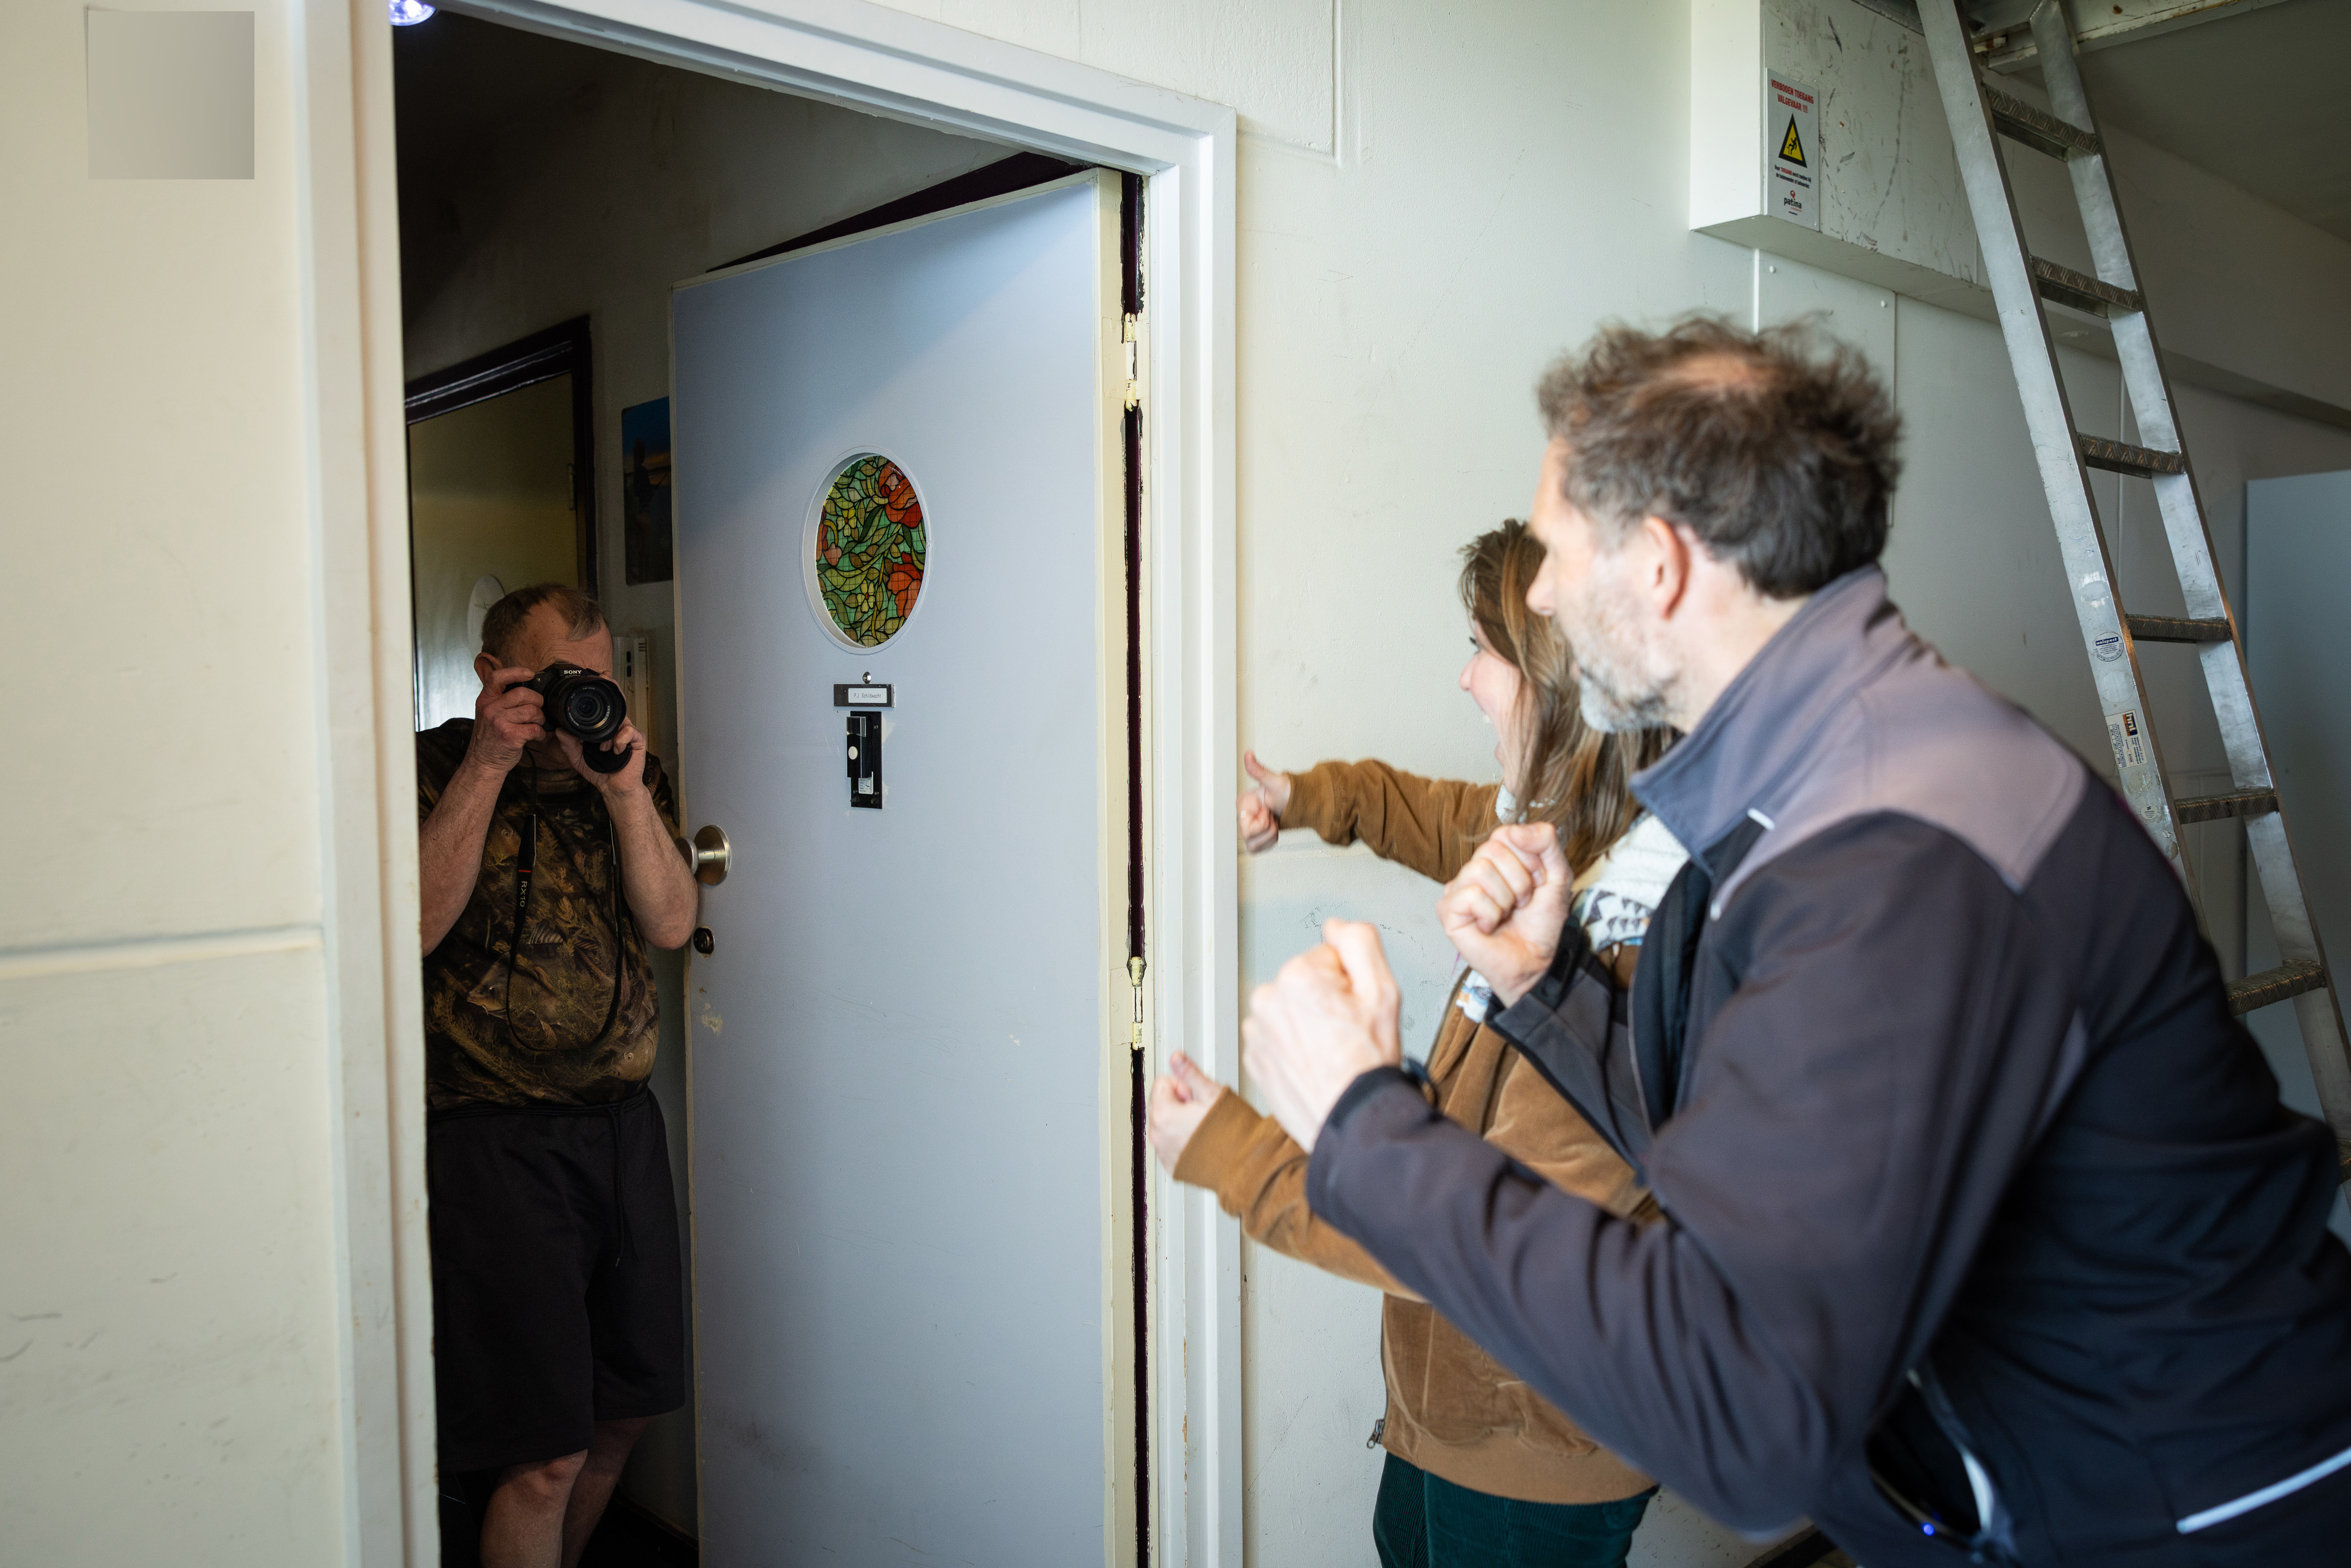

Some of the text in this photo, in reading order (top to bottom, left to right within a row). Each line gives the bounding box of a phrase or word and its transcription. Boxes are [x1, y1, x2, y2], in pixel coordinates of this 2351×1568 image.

[1771, 78, 1814, 104] VERBODEN TOEGANG
[1777, 94, 1802, 112] VALGEVAAR
[1784, 197, 1802, 209] patina
[2126, 713, 2137, 732] hnl
